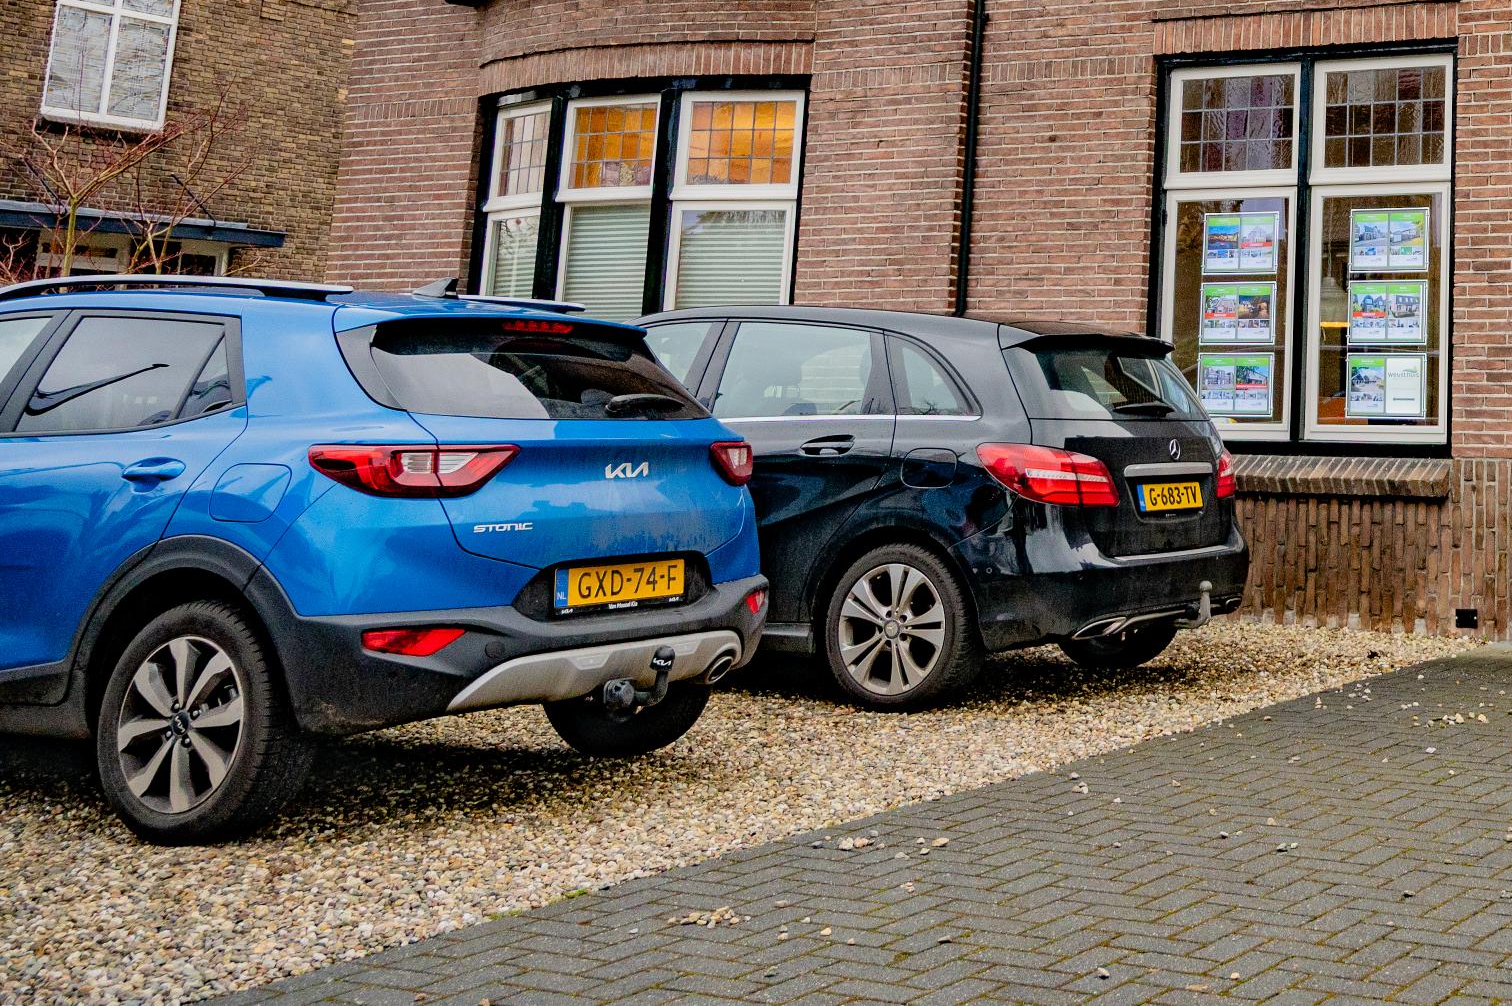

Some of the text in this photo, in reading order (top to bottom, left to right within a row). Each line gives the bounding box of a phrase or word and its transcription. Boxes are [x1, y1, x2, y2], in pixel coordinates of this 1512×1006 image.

[604, 461, 649, 480] KIA
[1149, 485, 1197, 507] G-683-TV
[473, 522, 534, 533] STONIC
[578, 564, 678, 599] GXD-74-F
[556, 592, 567, 600] NL
[652, 657, 672, 666] KIA
